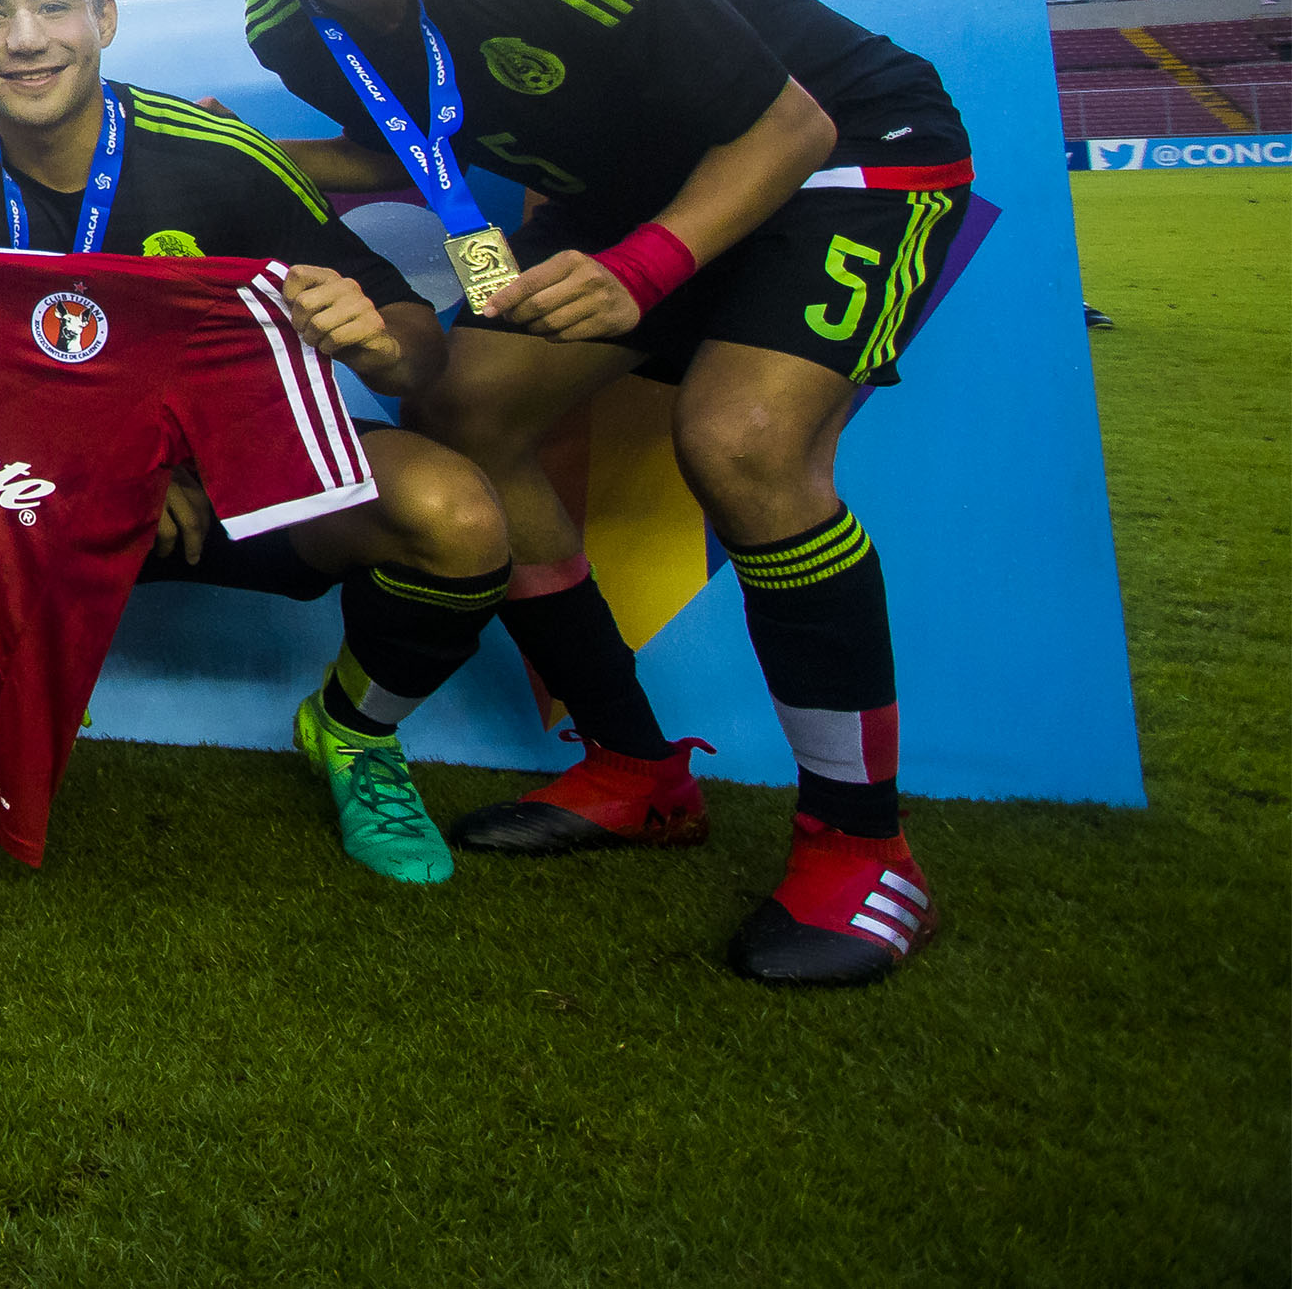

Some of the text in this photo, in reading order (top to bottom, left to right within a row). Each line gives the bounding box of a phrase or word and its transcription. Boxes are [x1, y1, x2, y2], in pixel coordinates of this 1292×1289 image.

[346, 54, 386, 103] CONCACAF
[106, 99, 117, 155] CONCACAF
[1152, 142, 1292, 166] @CONC
[10, 200, 20, 249] CONCAC
[83, 207, 100, 253] NCACAF
[44, 293, 105, 323] CLUB TIJUANA
[804, 234, 881, 341] 5
